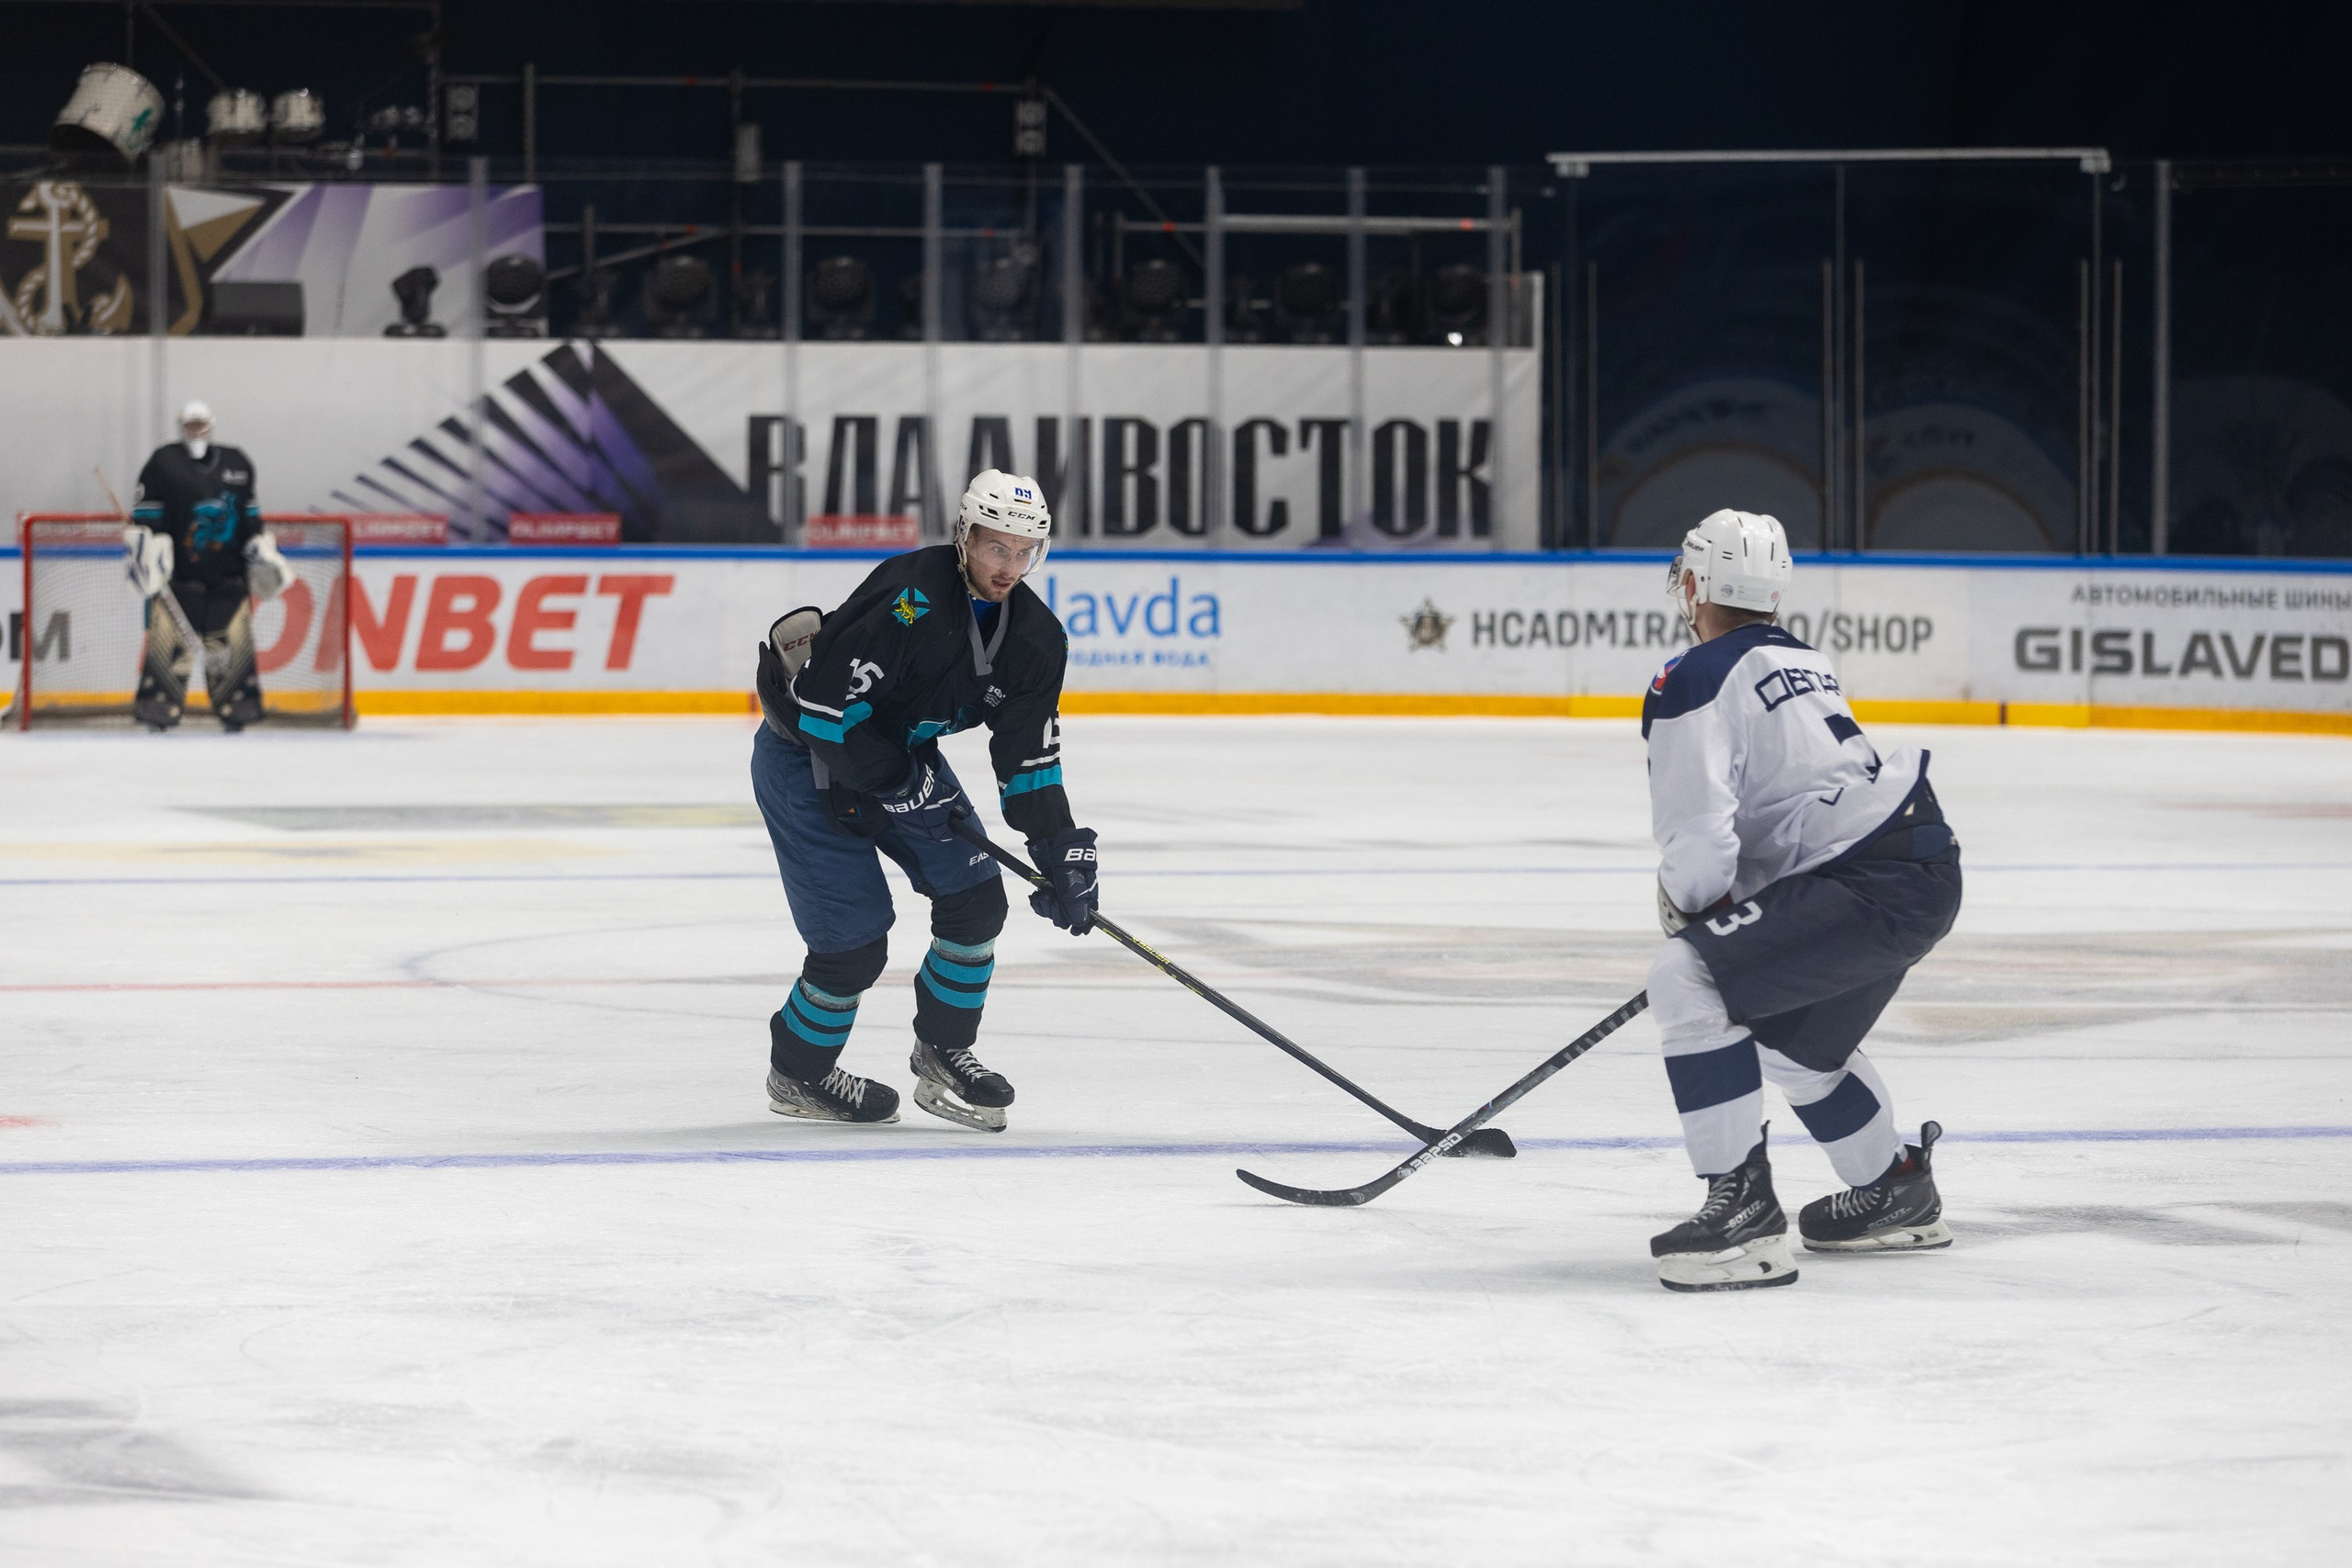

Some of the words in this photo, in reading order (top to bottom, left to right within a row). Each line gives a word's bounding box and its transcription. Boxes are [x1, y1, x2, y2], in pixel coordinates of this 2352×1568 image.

[1007, 511, 1035, 521] CCM
[1046, 574, 1221, 637] lavda
[2071, 583, 2278, 609] АВТОМОБИЛЬНЫЕ
[253, 575, 675, 672] ONBET
[2014, 626, 2351, 683] GISLAVED
[882, 763, 935, 814] BAUER
